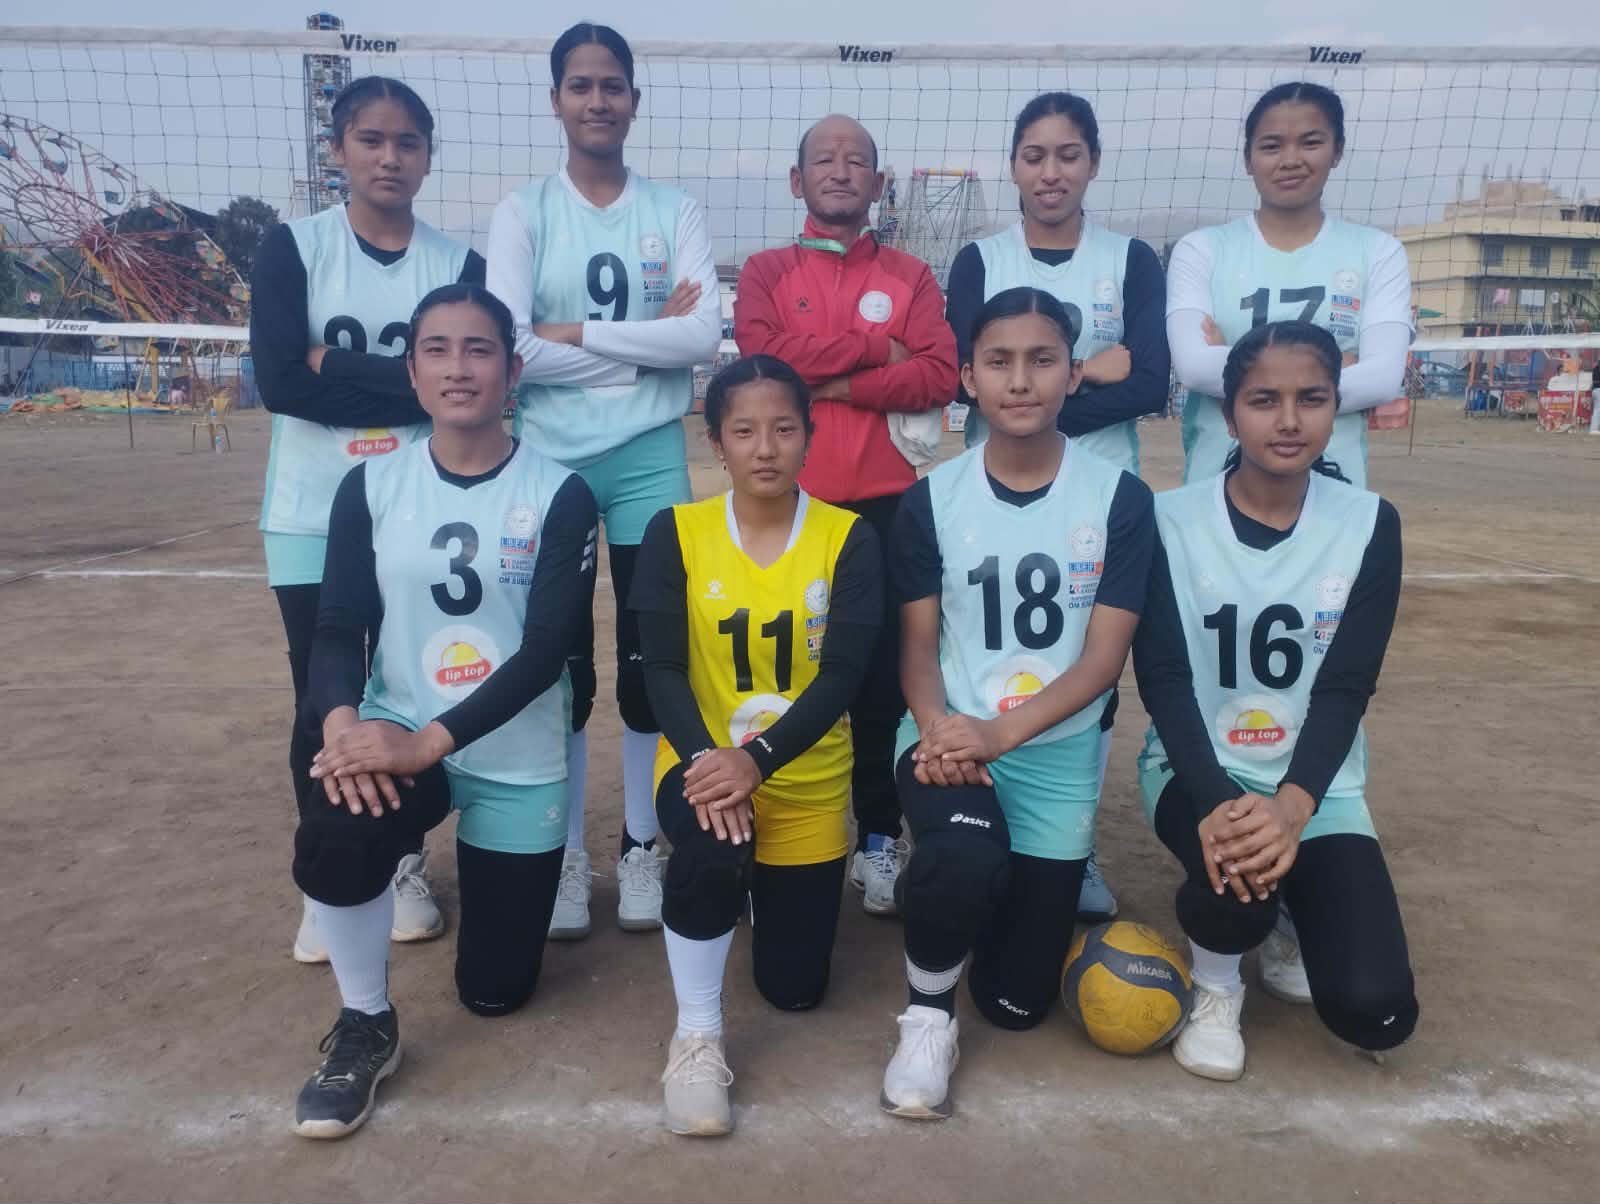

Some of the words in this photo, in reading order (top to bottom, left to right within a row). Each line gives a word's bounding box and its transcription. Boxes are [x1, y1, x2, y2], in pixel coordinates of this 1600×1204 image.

[340, 33, 397, 52] Vixen
[839, 45, 893, 62] Vixen
[1310, 46, 1362, 64] Vixen
[586, 252, 628, 321] 9
[429, 521, 483, 616] 3
[967, 552, 1064, 650] 18
[718, 607, 794, 692] 11
[1203, 603, 1304, 689] 16
[446, 669, 461, 681] tip
[464, 665, 485, 679] top
[1239, 730, 1254, 742] tip
[1258, 730, 1279, 742] top
